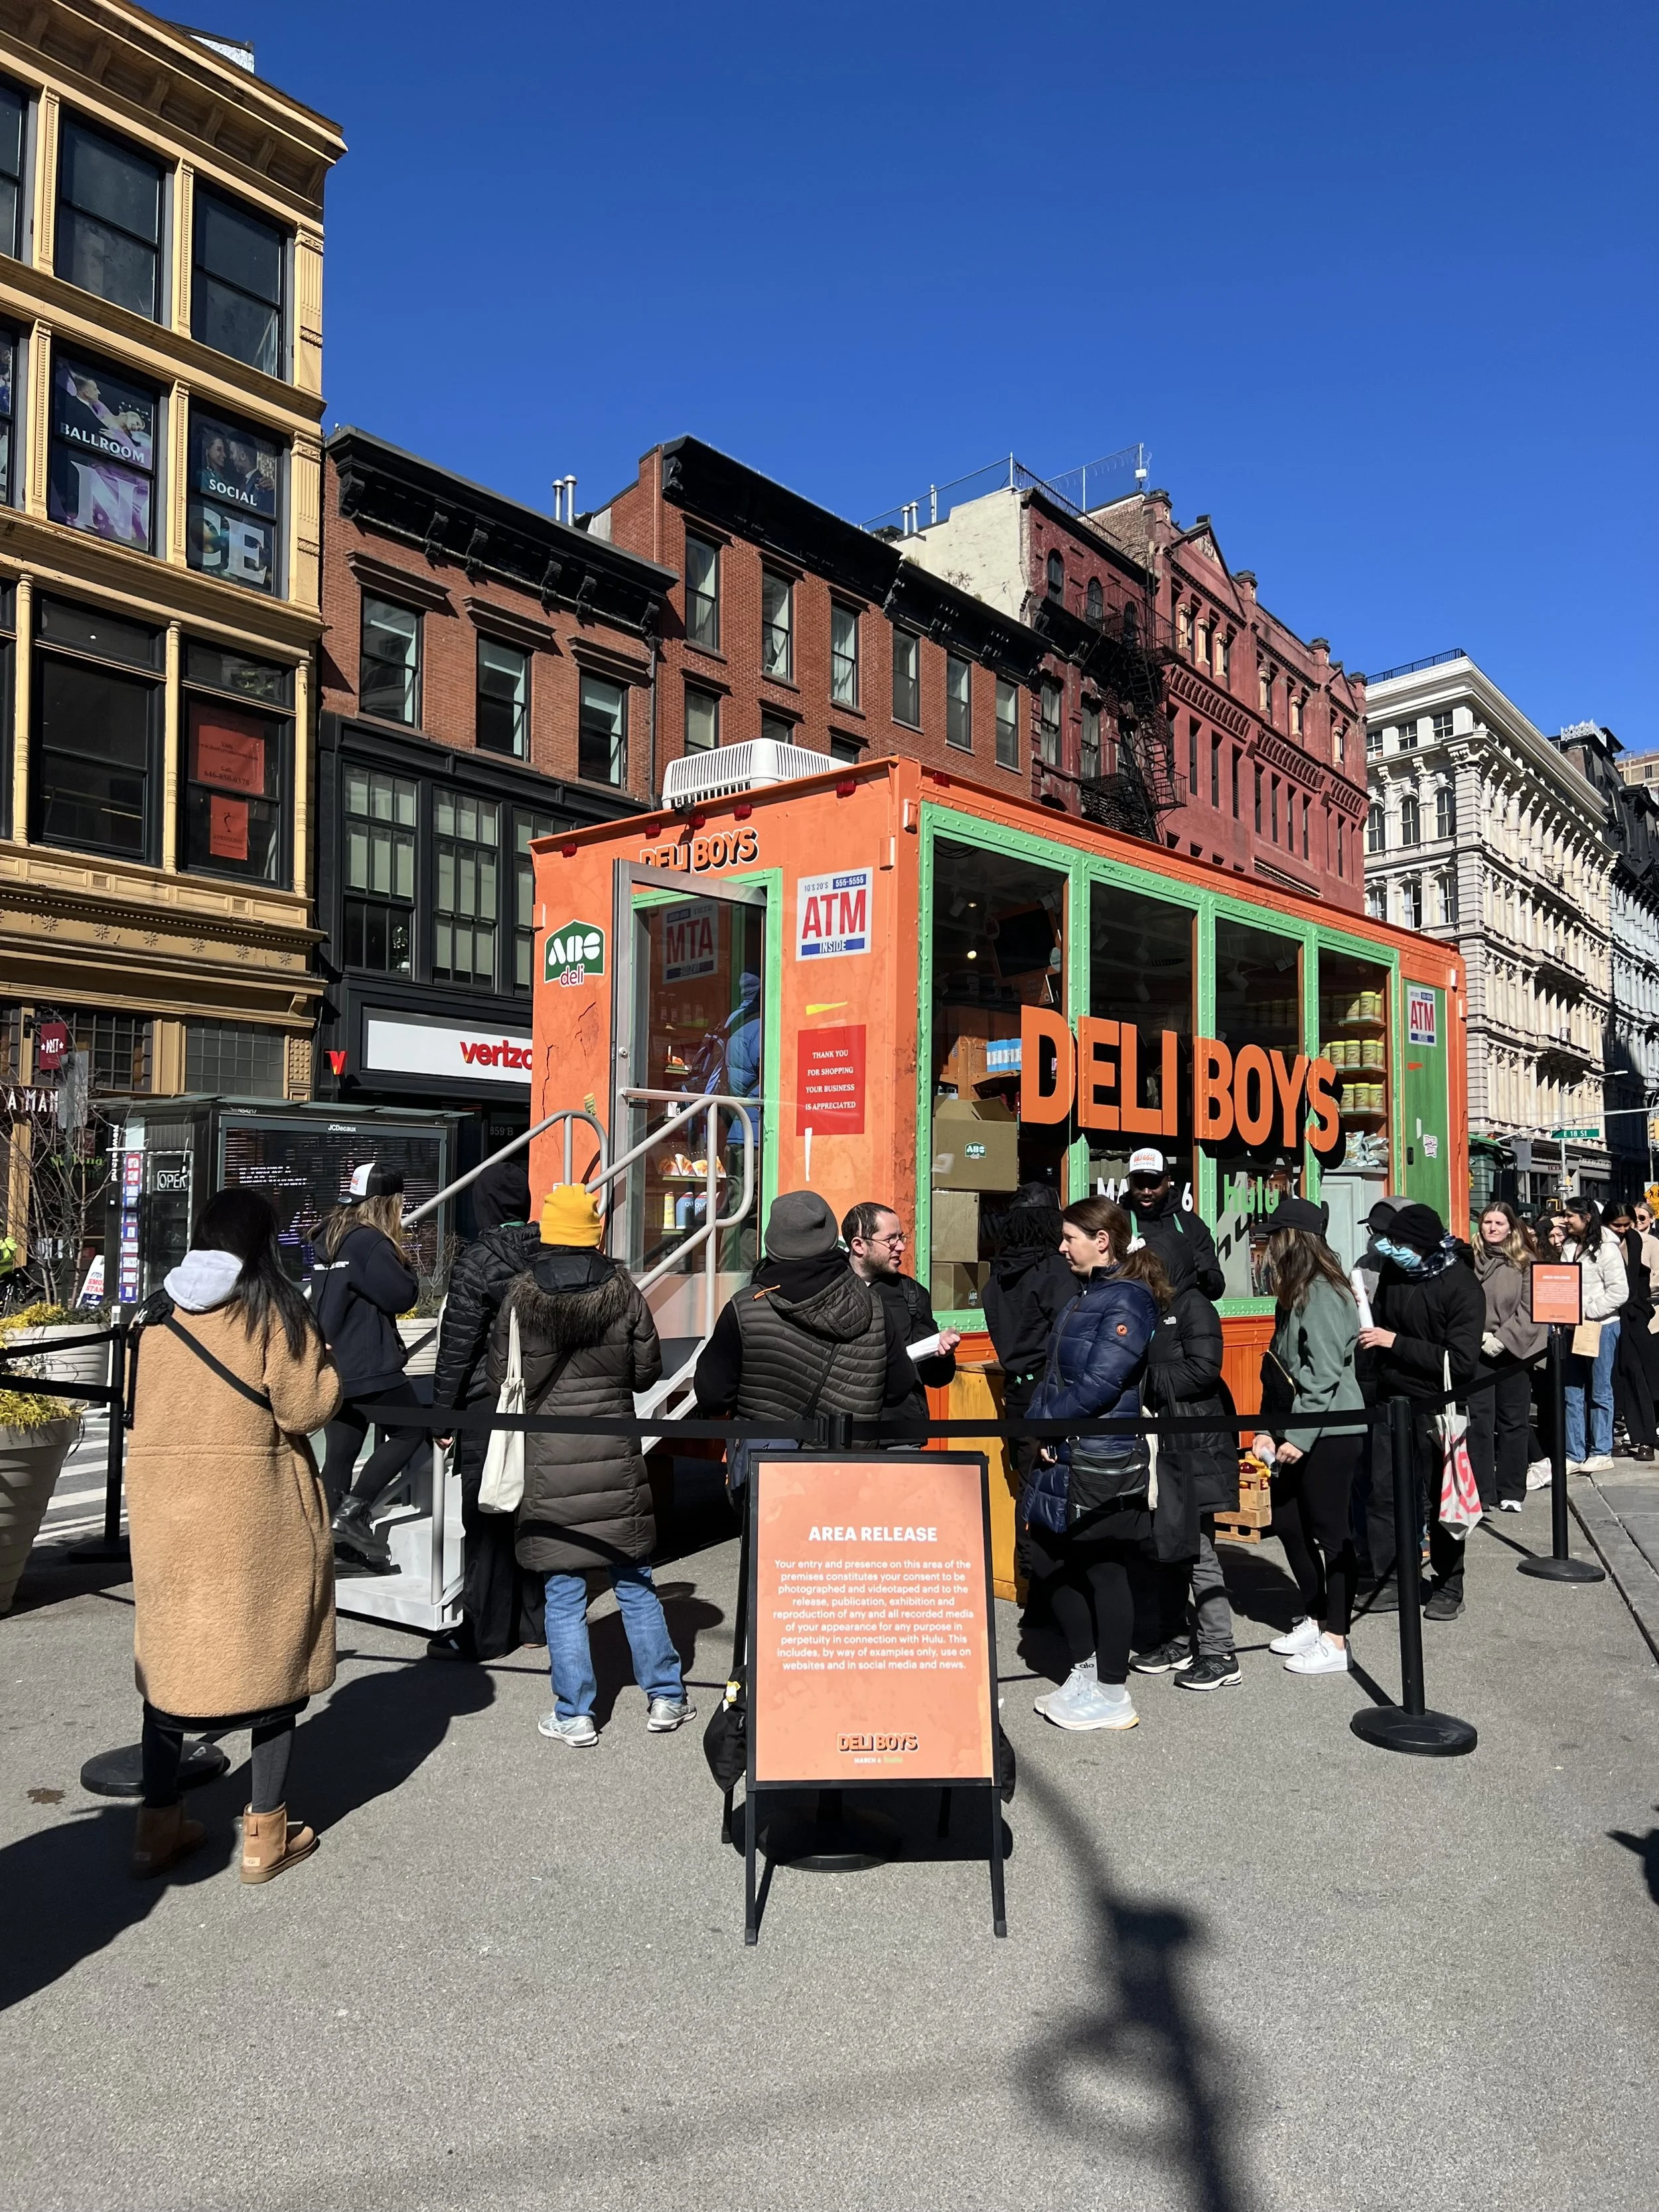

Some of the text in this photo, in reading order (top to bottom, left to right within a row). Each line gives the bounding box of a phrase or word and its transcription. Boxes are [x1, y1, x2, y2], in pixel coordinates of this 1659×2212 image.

[60, 422, 144, 464] BALLROOM
[209, 479, 257, 506] SOCIAL
[204, 770, 250, 786] 646-850-0378
[640, 827, 758, 873] DELI BOYS
[835, 875, 864, 887] 555-5555
[802, 889, 866, 939] ATM
[548, 932, 601, 966] ABC
[820, 940, 847, 954] INSIDE
[561, 965, 584, 986] deli
[1411, 1001, 1433, 1031] ATM
[460, 1040, 533, 1070] verizo
[812, 1051, 834, 1059] THANK
[821, 1067, 853, 1076] SHOPPING
[1021, 1005, 1339, 1152] DELI BOYS
[824, 1084, 855, 1092] BUSINESS
[7, 1089, 58, 1112] A MAN
[812, 1101, 856, 1110] APPRECIATED
[490, 1126, 504, 1136] 859
[966, 1145, 985, 1153] ABC
[1181, 1183, 1193, 1212] 6
[1224, 1174, 1279, 1214] hulu
[808, 1526, 937, 1542] AREA RELEASE
[775, 1559, 796, 1569] Your
[798, 1560, 822, 1570] entry
[825, 1559, 842, 1568] and
[845, 1561, 888, 1570] presence
[904, 1559, 920, 1569] this
[944, 1559, 954, 1569] of
[956, 1560, 971, 1570] the
[781, 1574, 824, 1583] premises
[881, 1574, 901, 1582] your
[954, 1572, 966, 1582] be
[778, 1584, 845, 1595] photographed
[848, 1585, 865, 1593] and
[868, 1584, 920, 1594] videotaped
[922, 1584, 939, 1593] and
[954, 1584, 968, 1594] the
[832, 1597, 887, 1607] publication,
[889, 1597, 935, 1606] exhibition
[938, 1597, 955, 1606] and
[773, 1609, 974, 1620] reproduction of any and all recorded media
[786, 1622, 795, 1632] of
[798, 1624, 818, 1633] your
[821, 1624, 877, 1633] appearance
[879, 1622, 892, 1631] for
[895, 1623, 910, 1632] any
[914, 1623, 951, 1632] purpose
[781, 1636, 830, 1645] perpetuity
[843, 1635, 897, 1644] connection
[899, 1635, 918, 1644] with
[922, 1635, 945, 1644] Hulu.
[949, 1634, 967, 1644] This
[777, 1647, 820, 1658] includes,
[823, 1648, 833, 1658] by
[837, 1649, 855, 1658] way
[858, 1647, 867, 1657] of
[870, 1648, 914, 1658] examples
[916, 1647, 938, 1658] only,
[783, 1662, 825, 1670] websites
[827, 1660, 845, 1670] and
[858, 1660, 885, 1670] social
[889, 1660, 917, 1670] media
[919, 1660, 937, 1670] and
[940, 1661, 966, 1670] news.
[838, 1733, 918, 1752] DELI BOYS
